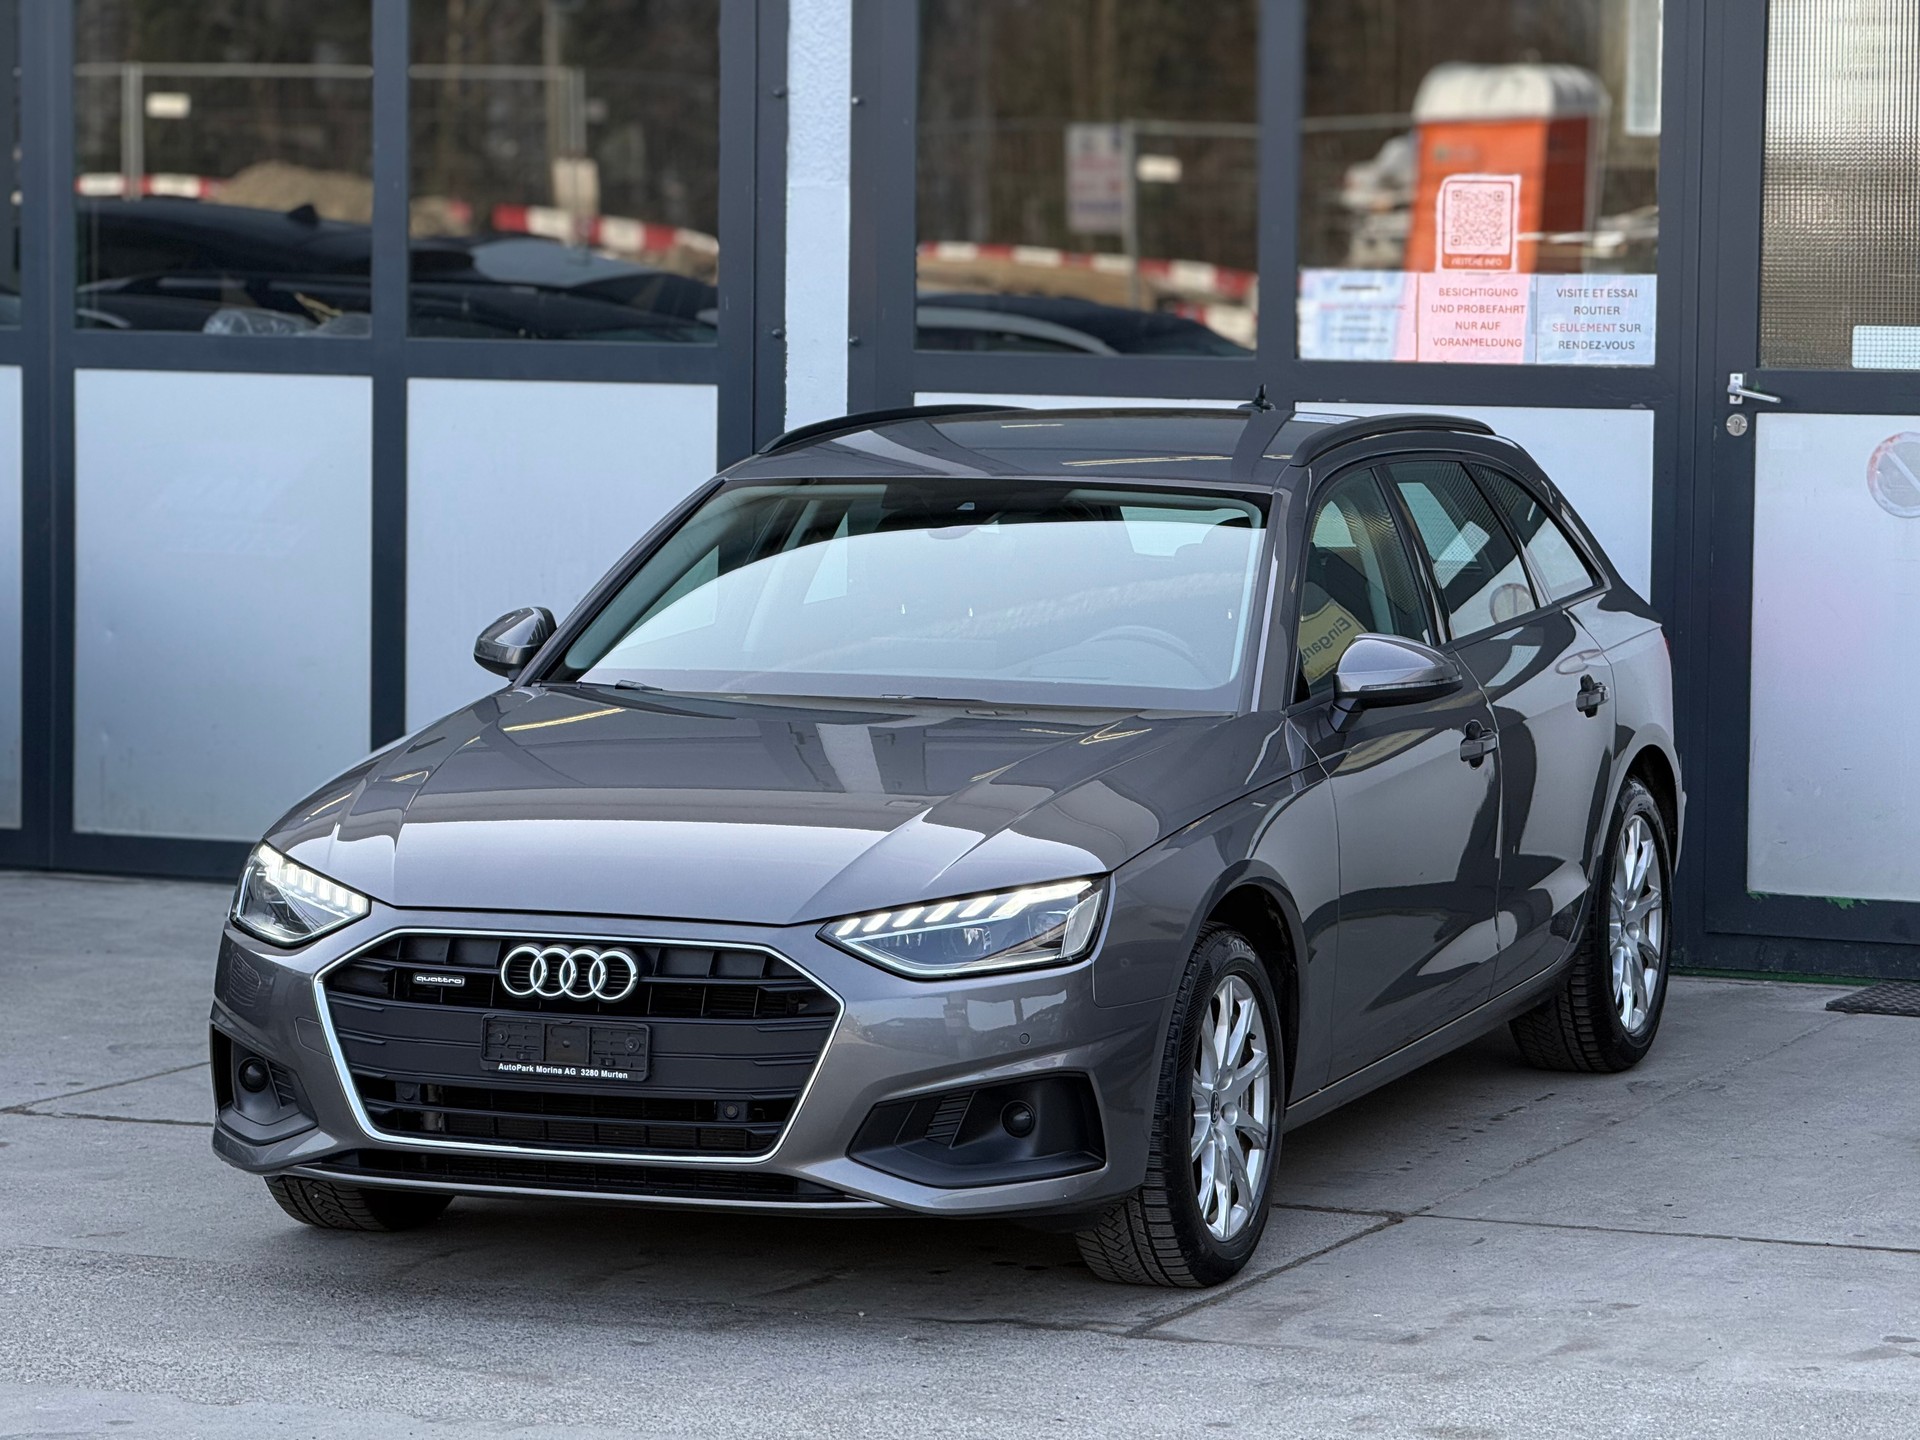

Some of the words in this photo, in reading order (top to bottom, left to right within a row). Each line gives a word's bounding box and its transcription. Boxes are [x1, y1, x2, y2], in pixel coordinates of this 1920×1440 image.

[1438, 287, 1519, 297] BESICHTIGUNG
[1556, 288, 1590, 298] VISITE
[1592, 288, 1605, 298] ET
[1607, 288, 1638, 298] ESSAI
[1431, 304, 1455, 313] UND
[1457, 304, 1526, 314] PROBEFAHRT
[1573, 305, 1621, 316] ROUTIER
[1455, 321, 1478, 331] NUR
[1480, 321, 1502, 331] AUF
[1552, 323, 1617, 333] SEULEMENT
[1618, 323, 1642, 333] SUR
[1432, 337, 1523, 348] VORANMELDUNG
[1558, 340, 1636, 350] RENDEZ-VOUS
[416, 976, 462, 984] quattro
[498, 1063, 534, 1073] AutoPark
[536, 1065, 562, 1075] Morina
[564, 1067, 576, 1076] AG
[580, 1068, 599, 1077] 3280
[600, 1070, 628, 1079] Murten
